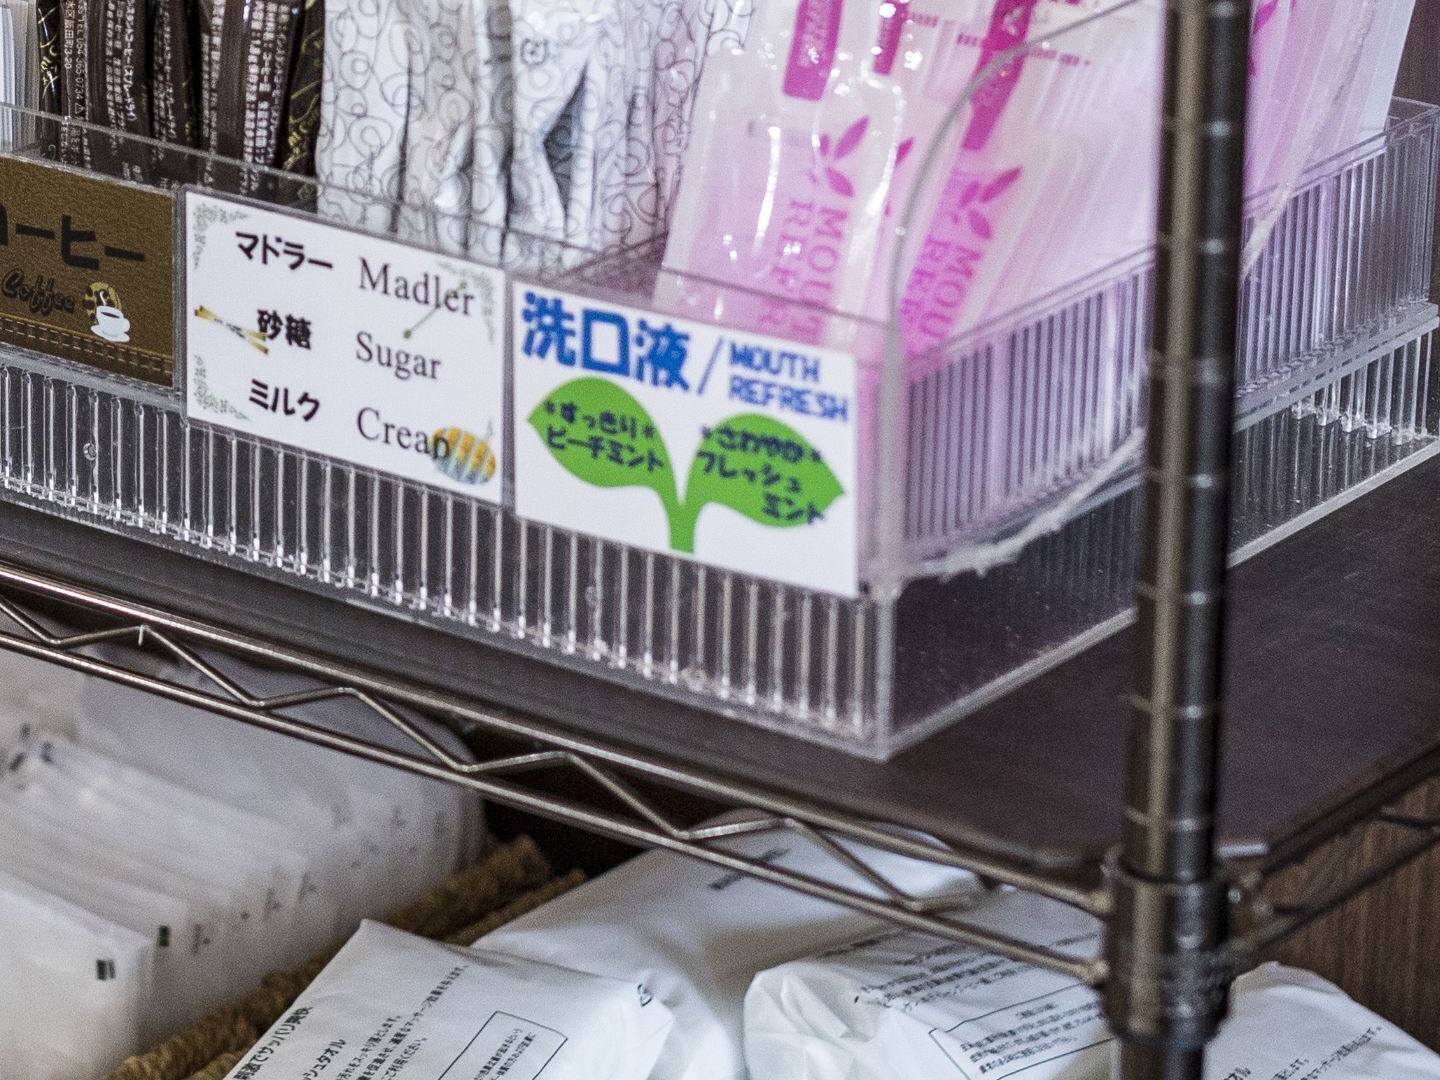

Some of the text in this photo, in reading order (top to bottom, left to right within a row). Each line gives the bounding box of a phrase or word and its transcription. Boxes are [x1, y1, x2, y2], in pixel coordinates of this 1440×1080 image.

[234, 230, 333, 273] マドラー
[1, 268, 76, 315] Coffee
[358, 257, 474, 318] Madler
[257, 309, 312, 351] 砂糖
[522, 290, 690, 392] 洗口液
[356, 331, 441, 380] Sugar
[729, 340, 820, 382] MOUTH
[249, 378, 320, 422] ミルク
[729, 375, 848, 421] REFRESH
